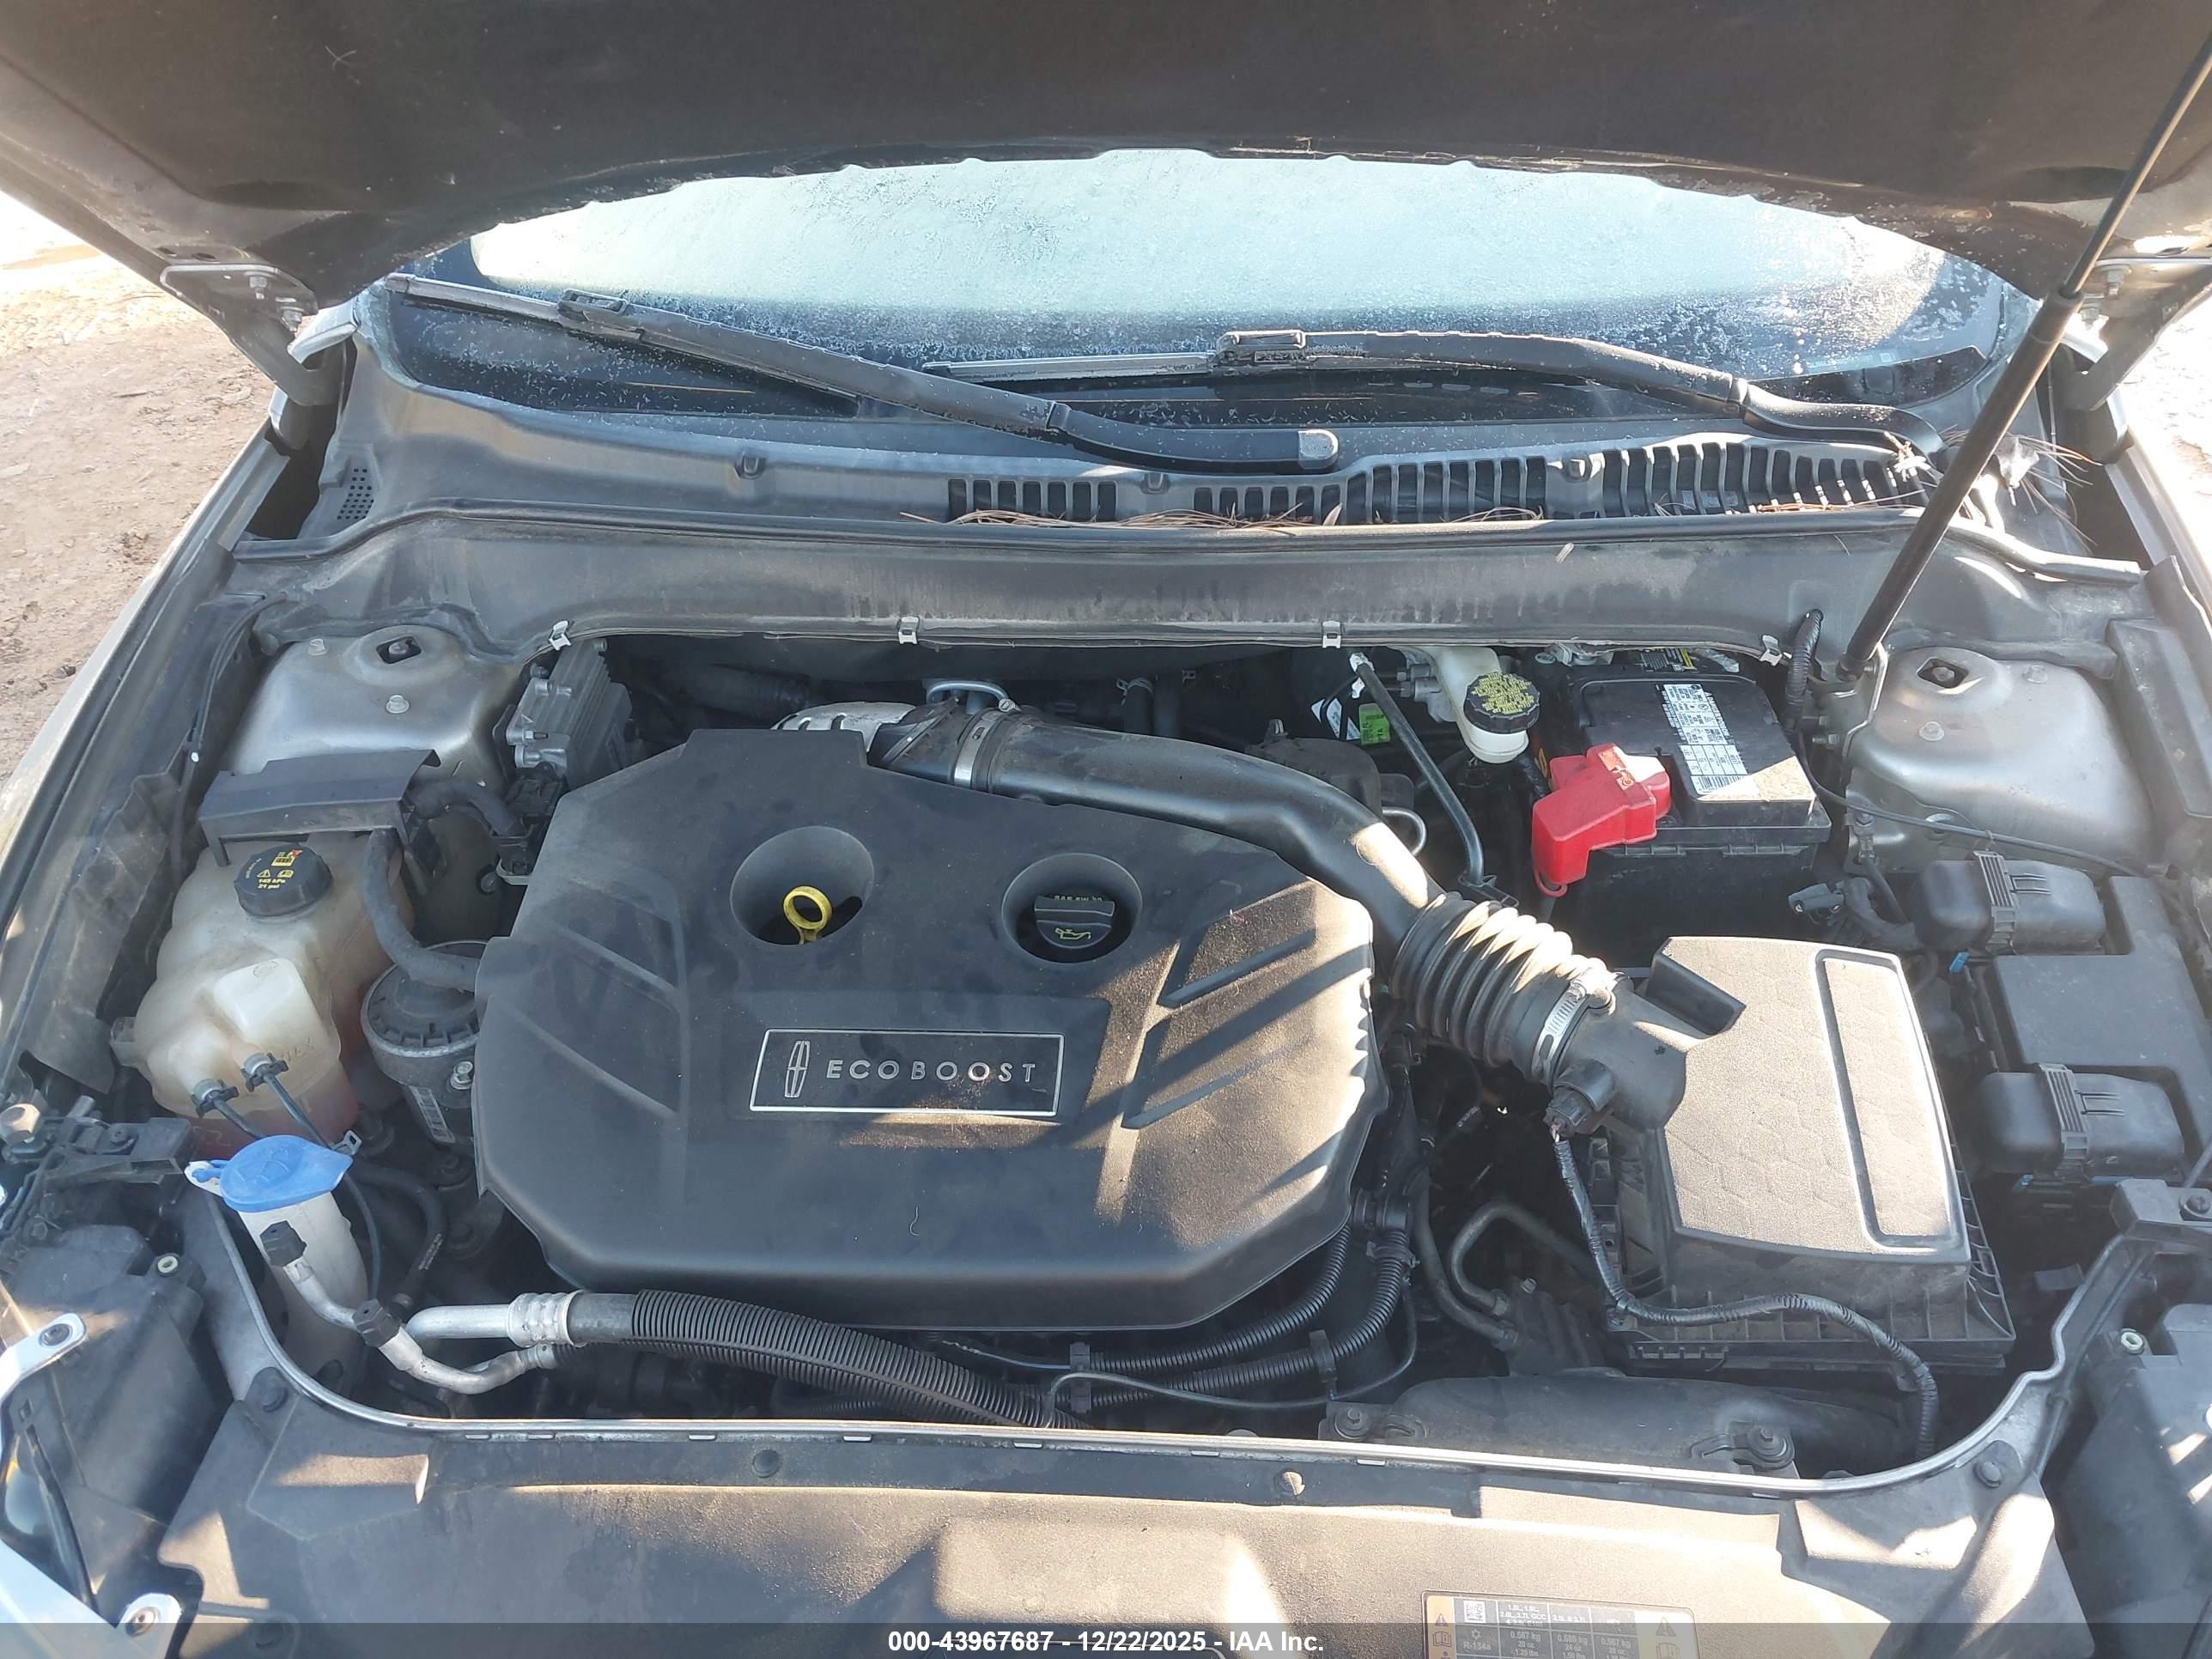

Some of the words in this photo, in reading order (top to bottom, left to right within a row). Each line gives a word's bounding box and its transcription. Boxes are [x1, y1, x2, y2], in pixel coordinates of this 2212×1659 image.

[826, 1060, 1036, 1082] ECOBOOST
[1531, 1632, 1541, 1643] kg
[1578, 1636, 1589, 1646] kg
[1463, 1641, 1492, 1650] R-134a
